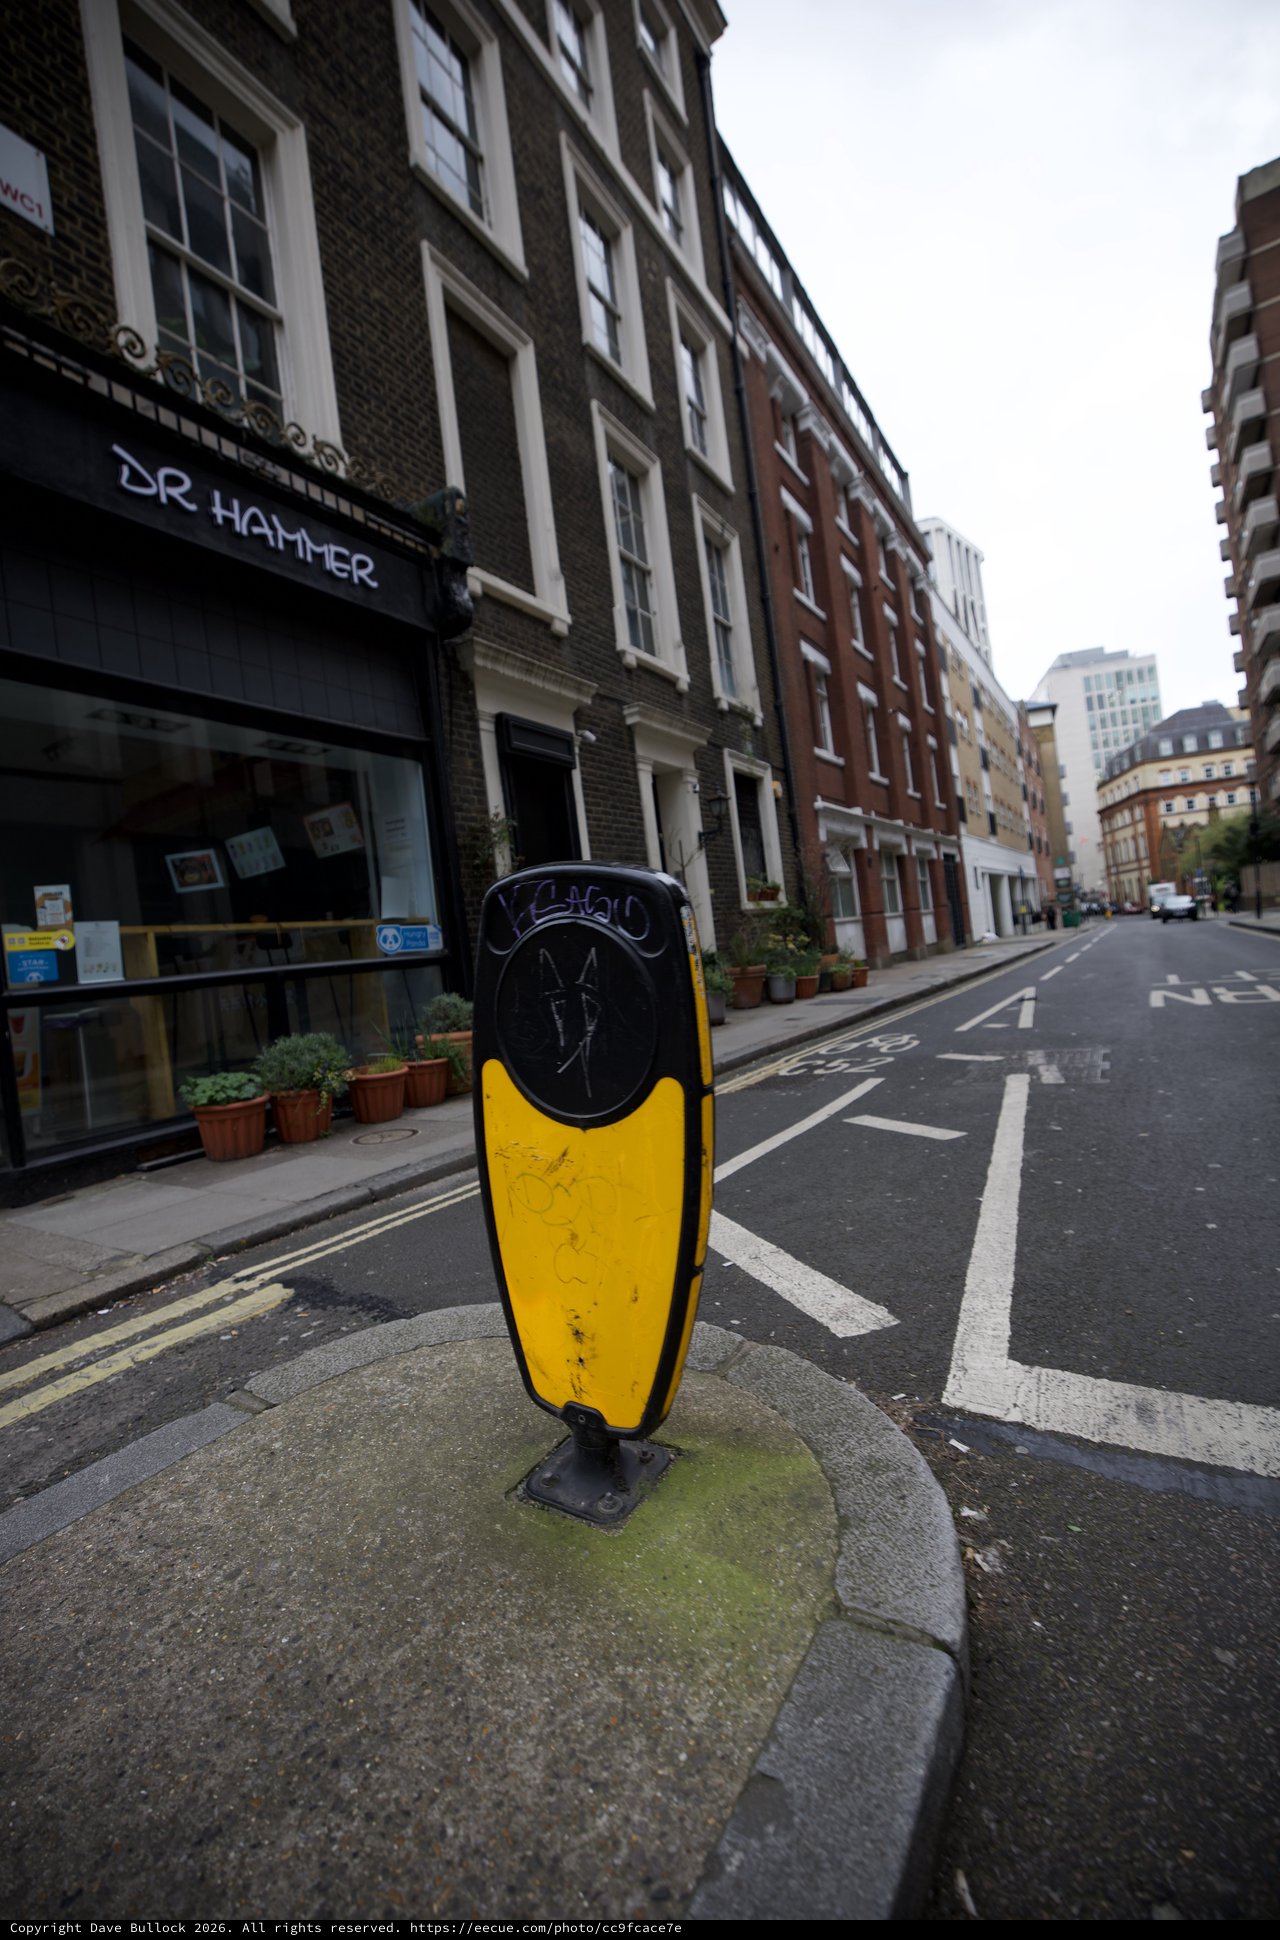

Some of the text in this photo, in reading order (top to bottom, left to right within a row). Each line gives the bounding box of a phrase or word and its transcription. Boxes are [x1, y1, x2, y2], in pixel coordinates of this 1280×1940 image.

[0, 178, 43, 218] WC1
[111, 444, 379, 588] DR HAMMER
[777, 1056, 896, 1077] C52
